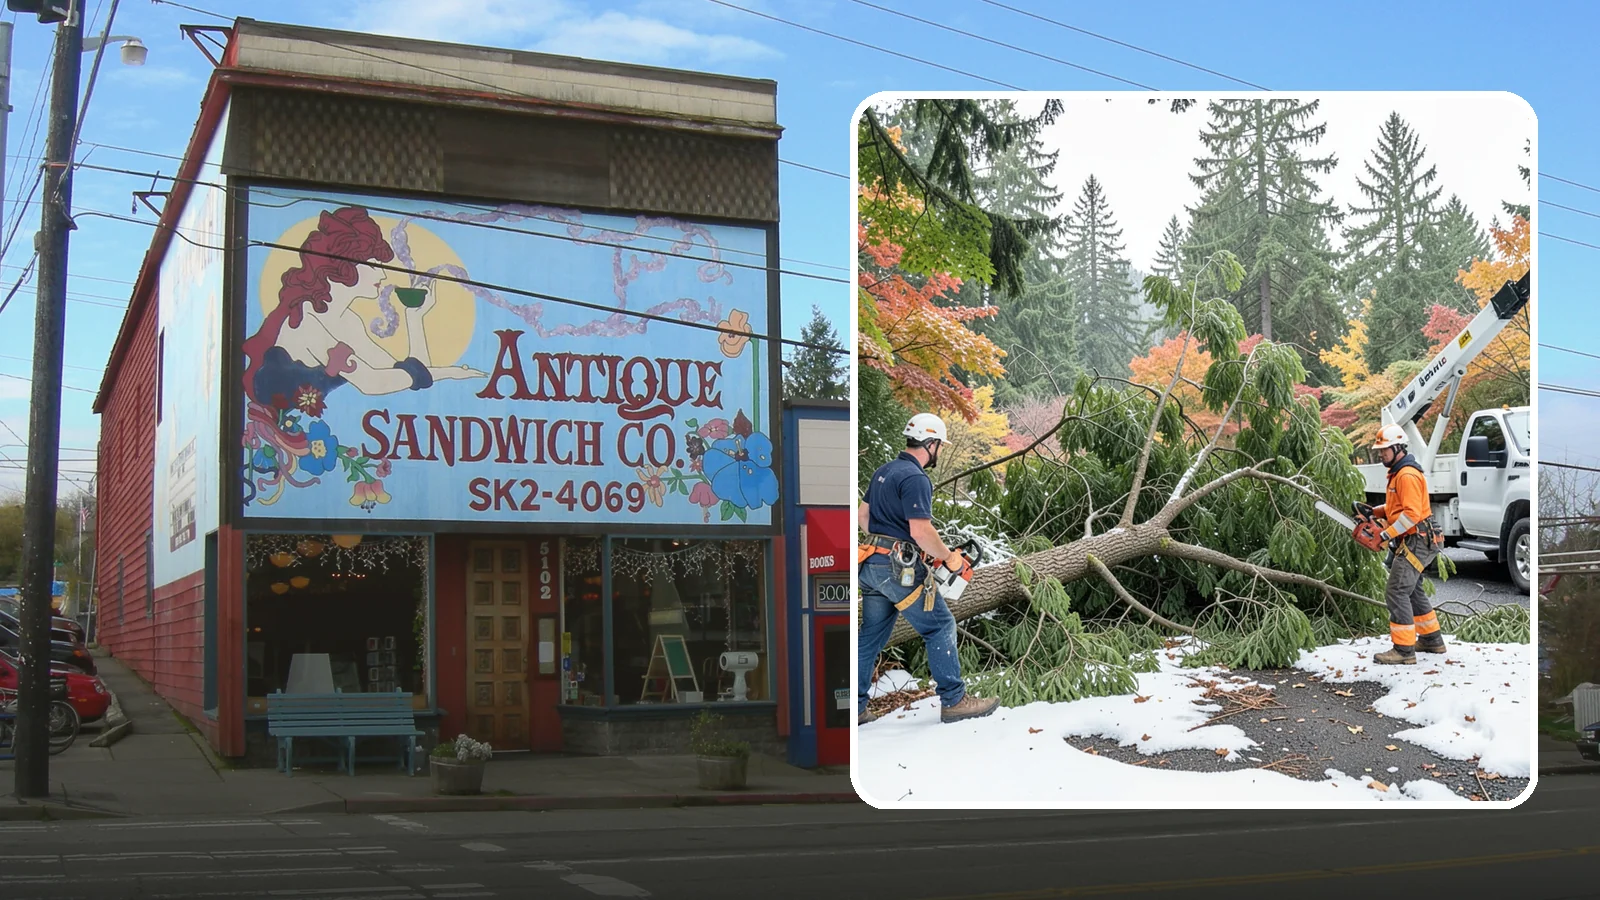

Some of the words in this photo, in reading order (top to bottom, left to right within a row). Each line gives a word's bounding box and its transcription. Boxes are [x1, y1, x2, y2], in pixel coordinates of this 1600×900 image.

[475, 328, 724, 420] ANTIQUE
[361, 408, 605, 467] SANDWICH
[616, 421, 685, 469] CO.
[468, 476, 645, 513] SK2-4069
[540, 541, 552, 600] 5102
[809, 554, 835, 569] BOOKS
